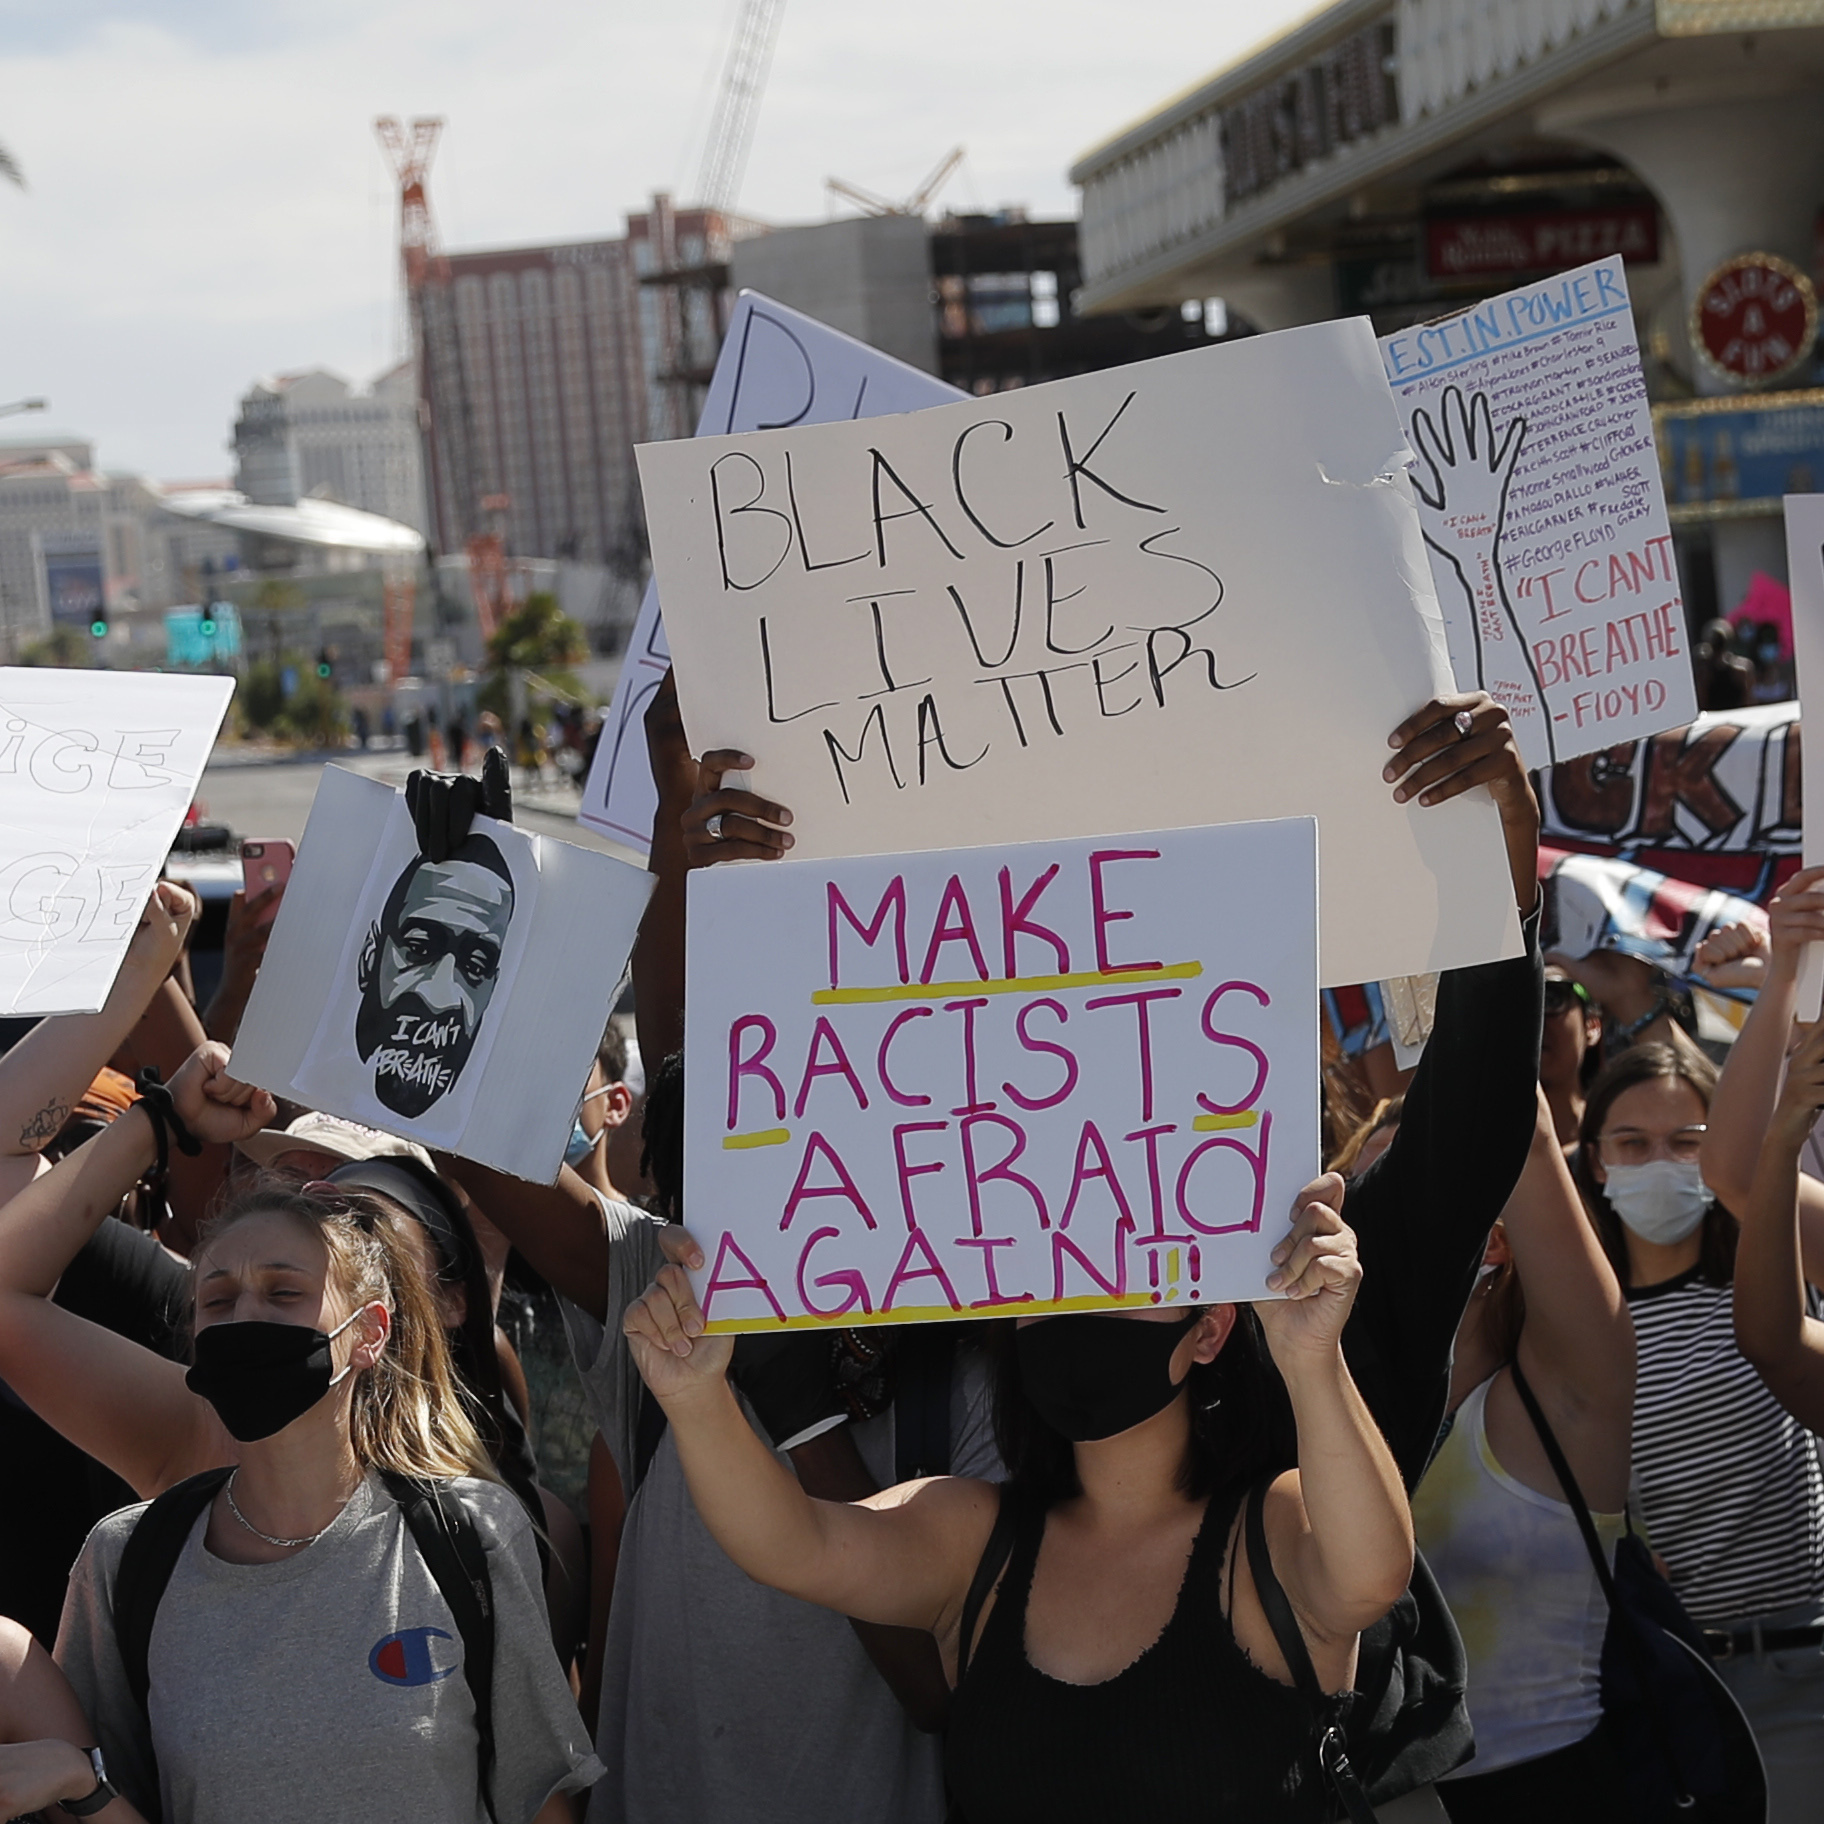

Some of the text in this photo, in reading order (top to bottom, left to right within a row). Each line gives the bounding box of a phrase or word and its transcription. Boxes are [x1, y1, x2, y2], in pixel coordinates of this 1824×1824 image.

[1741, 304, 1766, 335] A
[709, 390, 1170, 591] BLACK
[1573, 533, 1674, 605] CANT
[820, 624, 1260, 805] MATTER
[825, 848, 1164, 992] MAKE
[726, 978, 1273, 1132] RACISTS
